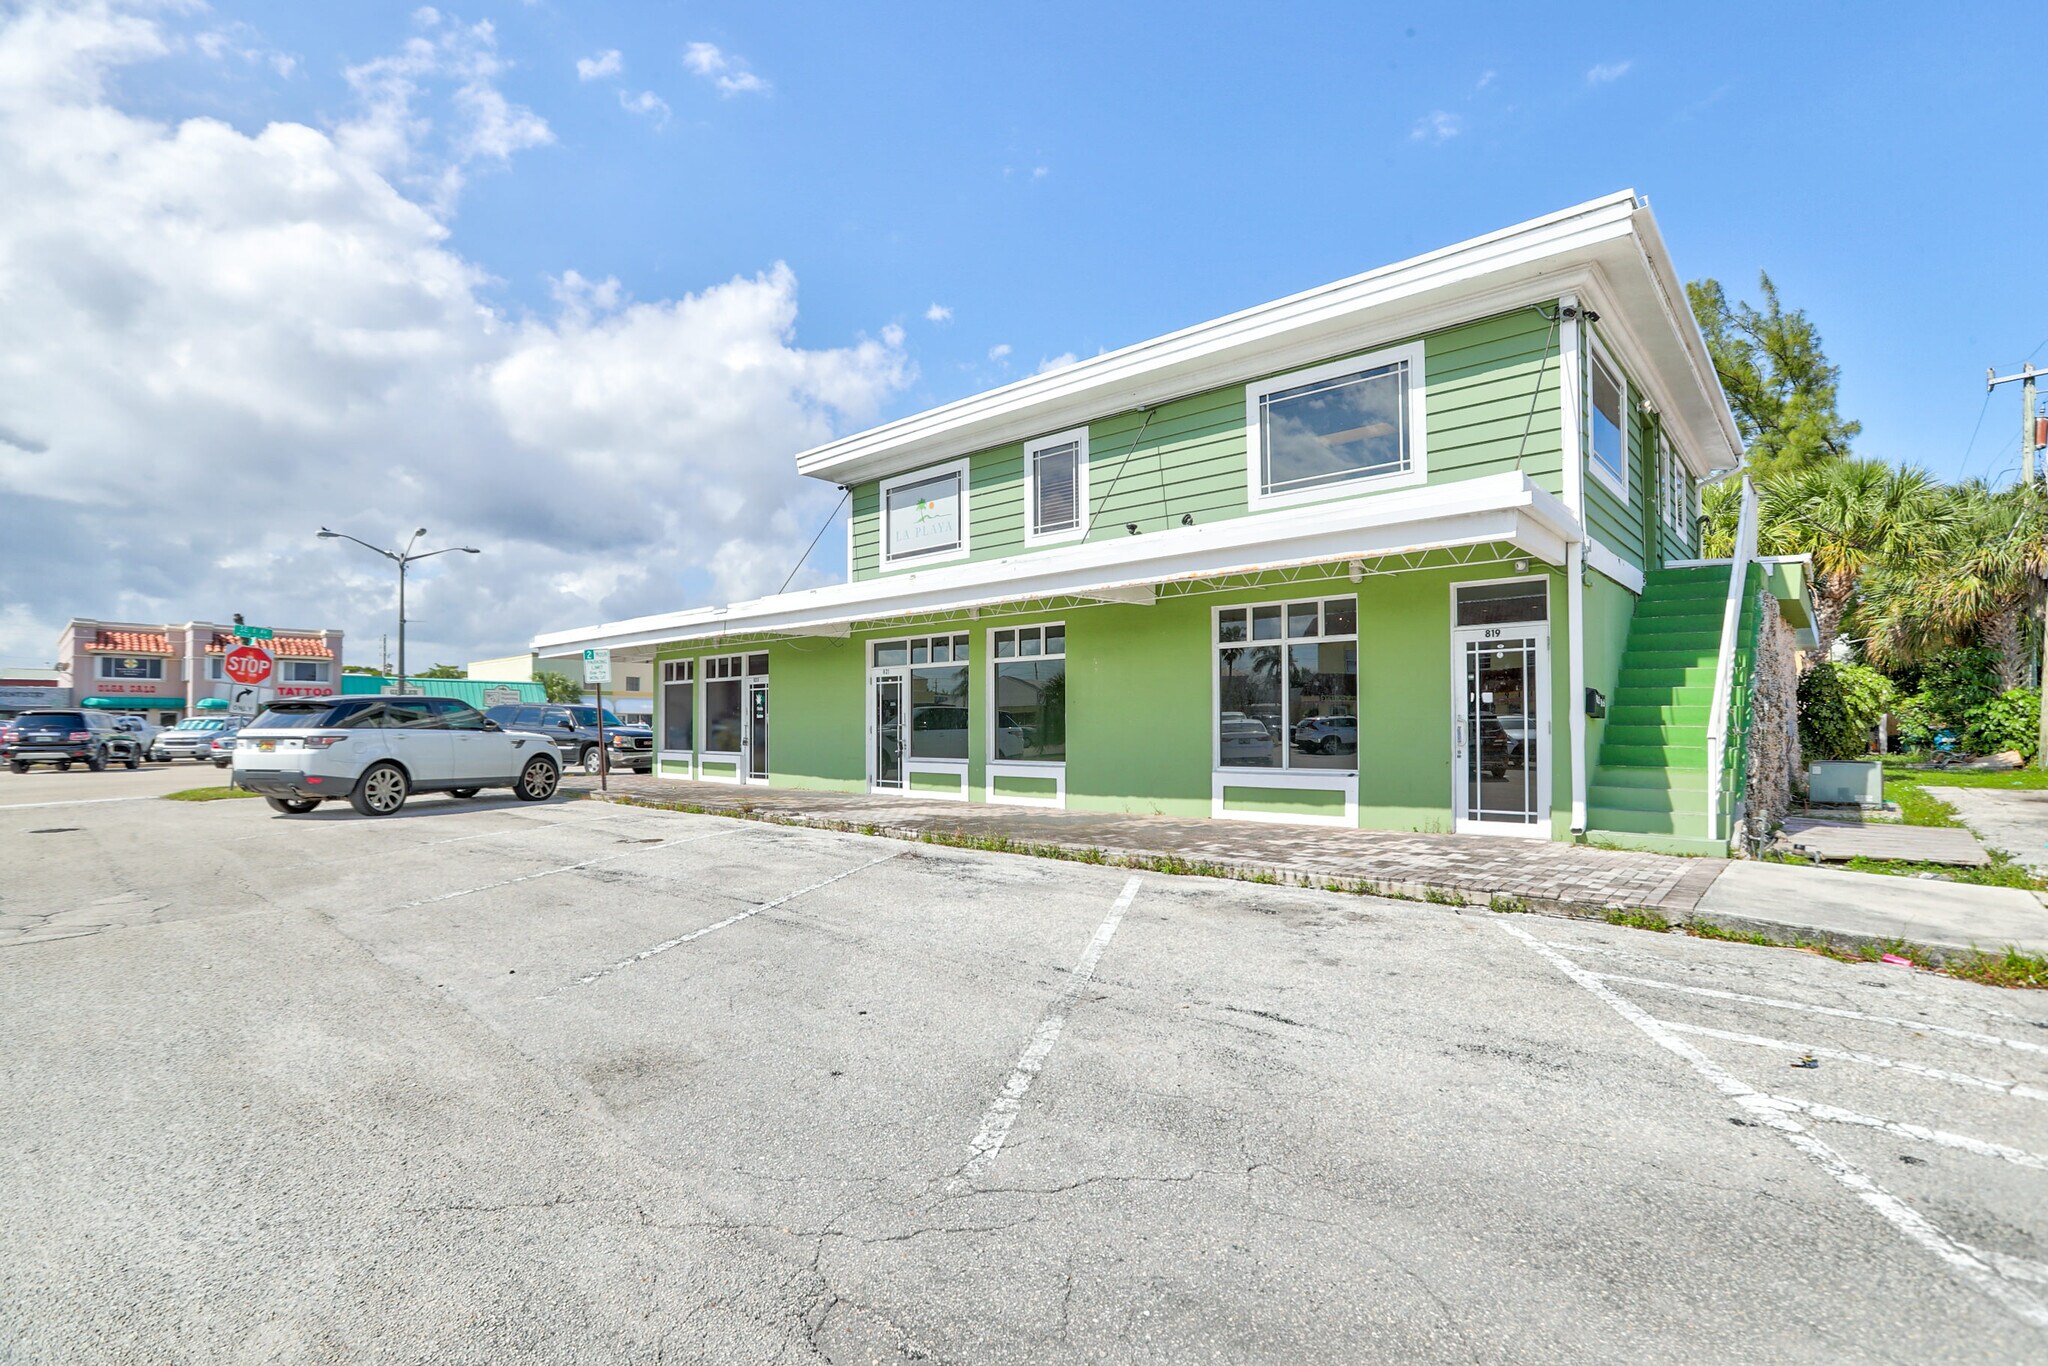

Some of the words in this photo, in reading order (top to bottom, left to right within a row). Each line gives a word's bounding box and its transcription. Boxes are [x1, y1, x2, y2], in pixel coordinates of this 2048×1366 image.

[896, 529, 910, 543] LA
[915, 521, 953, 538] PLAYA
[1485, 628, 1501, 638] 819
[586, 650, 592, 659] 2
[227, 656, 271, 674] STOP
[277, 687, 333, 697] TATTOO
[232, 703, 253, 712] ONLY
